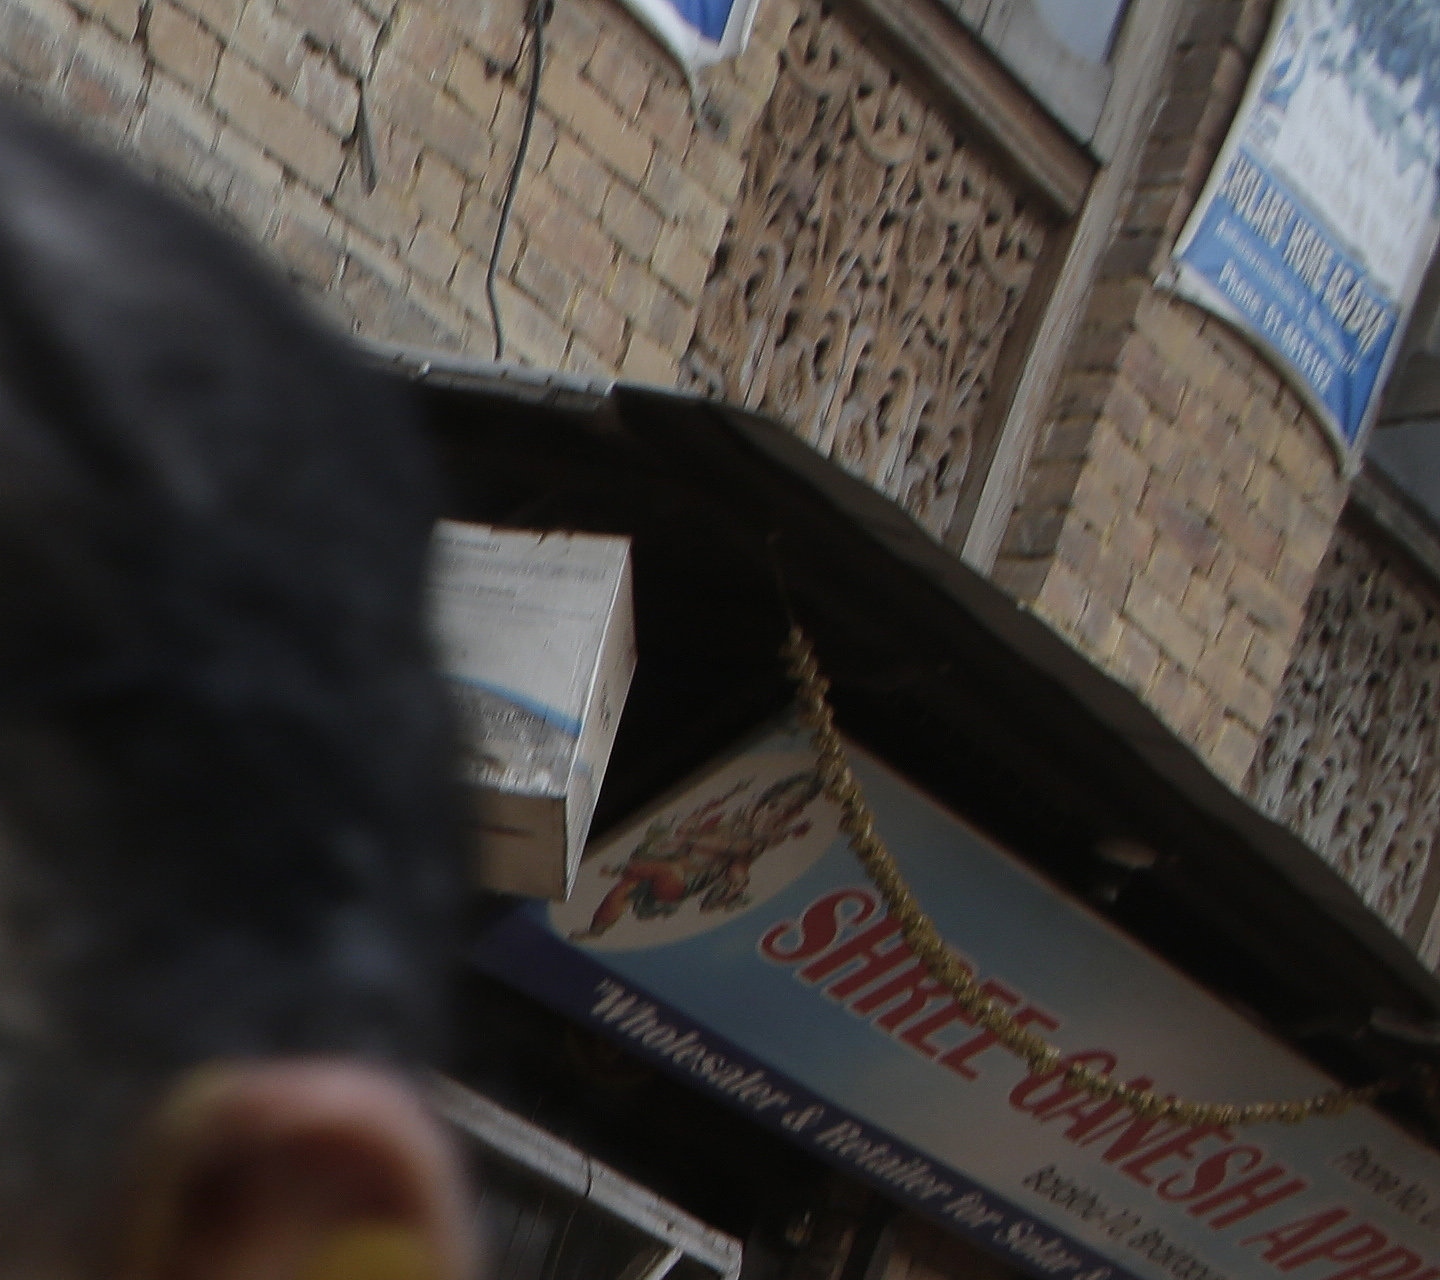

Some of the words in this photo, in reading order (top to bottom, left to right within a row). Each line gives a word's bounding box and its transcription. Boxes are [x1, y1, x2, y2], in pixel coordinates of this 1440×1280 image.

[759, 887, 1060, 1081] SHREE
[1007, 1050, 1309, 1231] GANESH
[782, 1104, 825, 1132] &
[815, 1119, 952, 1199] Retailer
[943, 1192, 1005, 1229] for
[994, 1222, 1082, 1273] Solar
